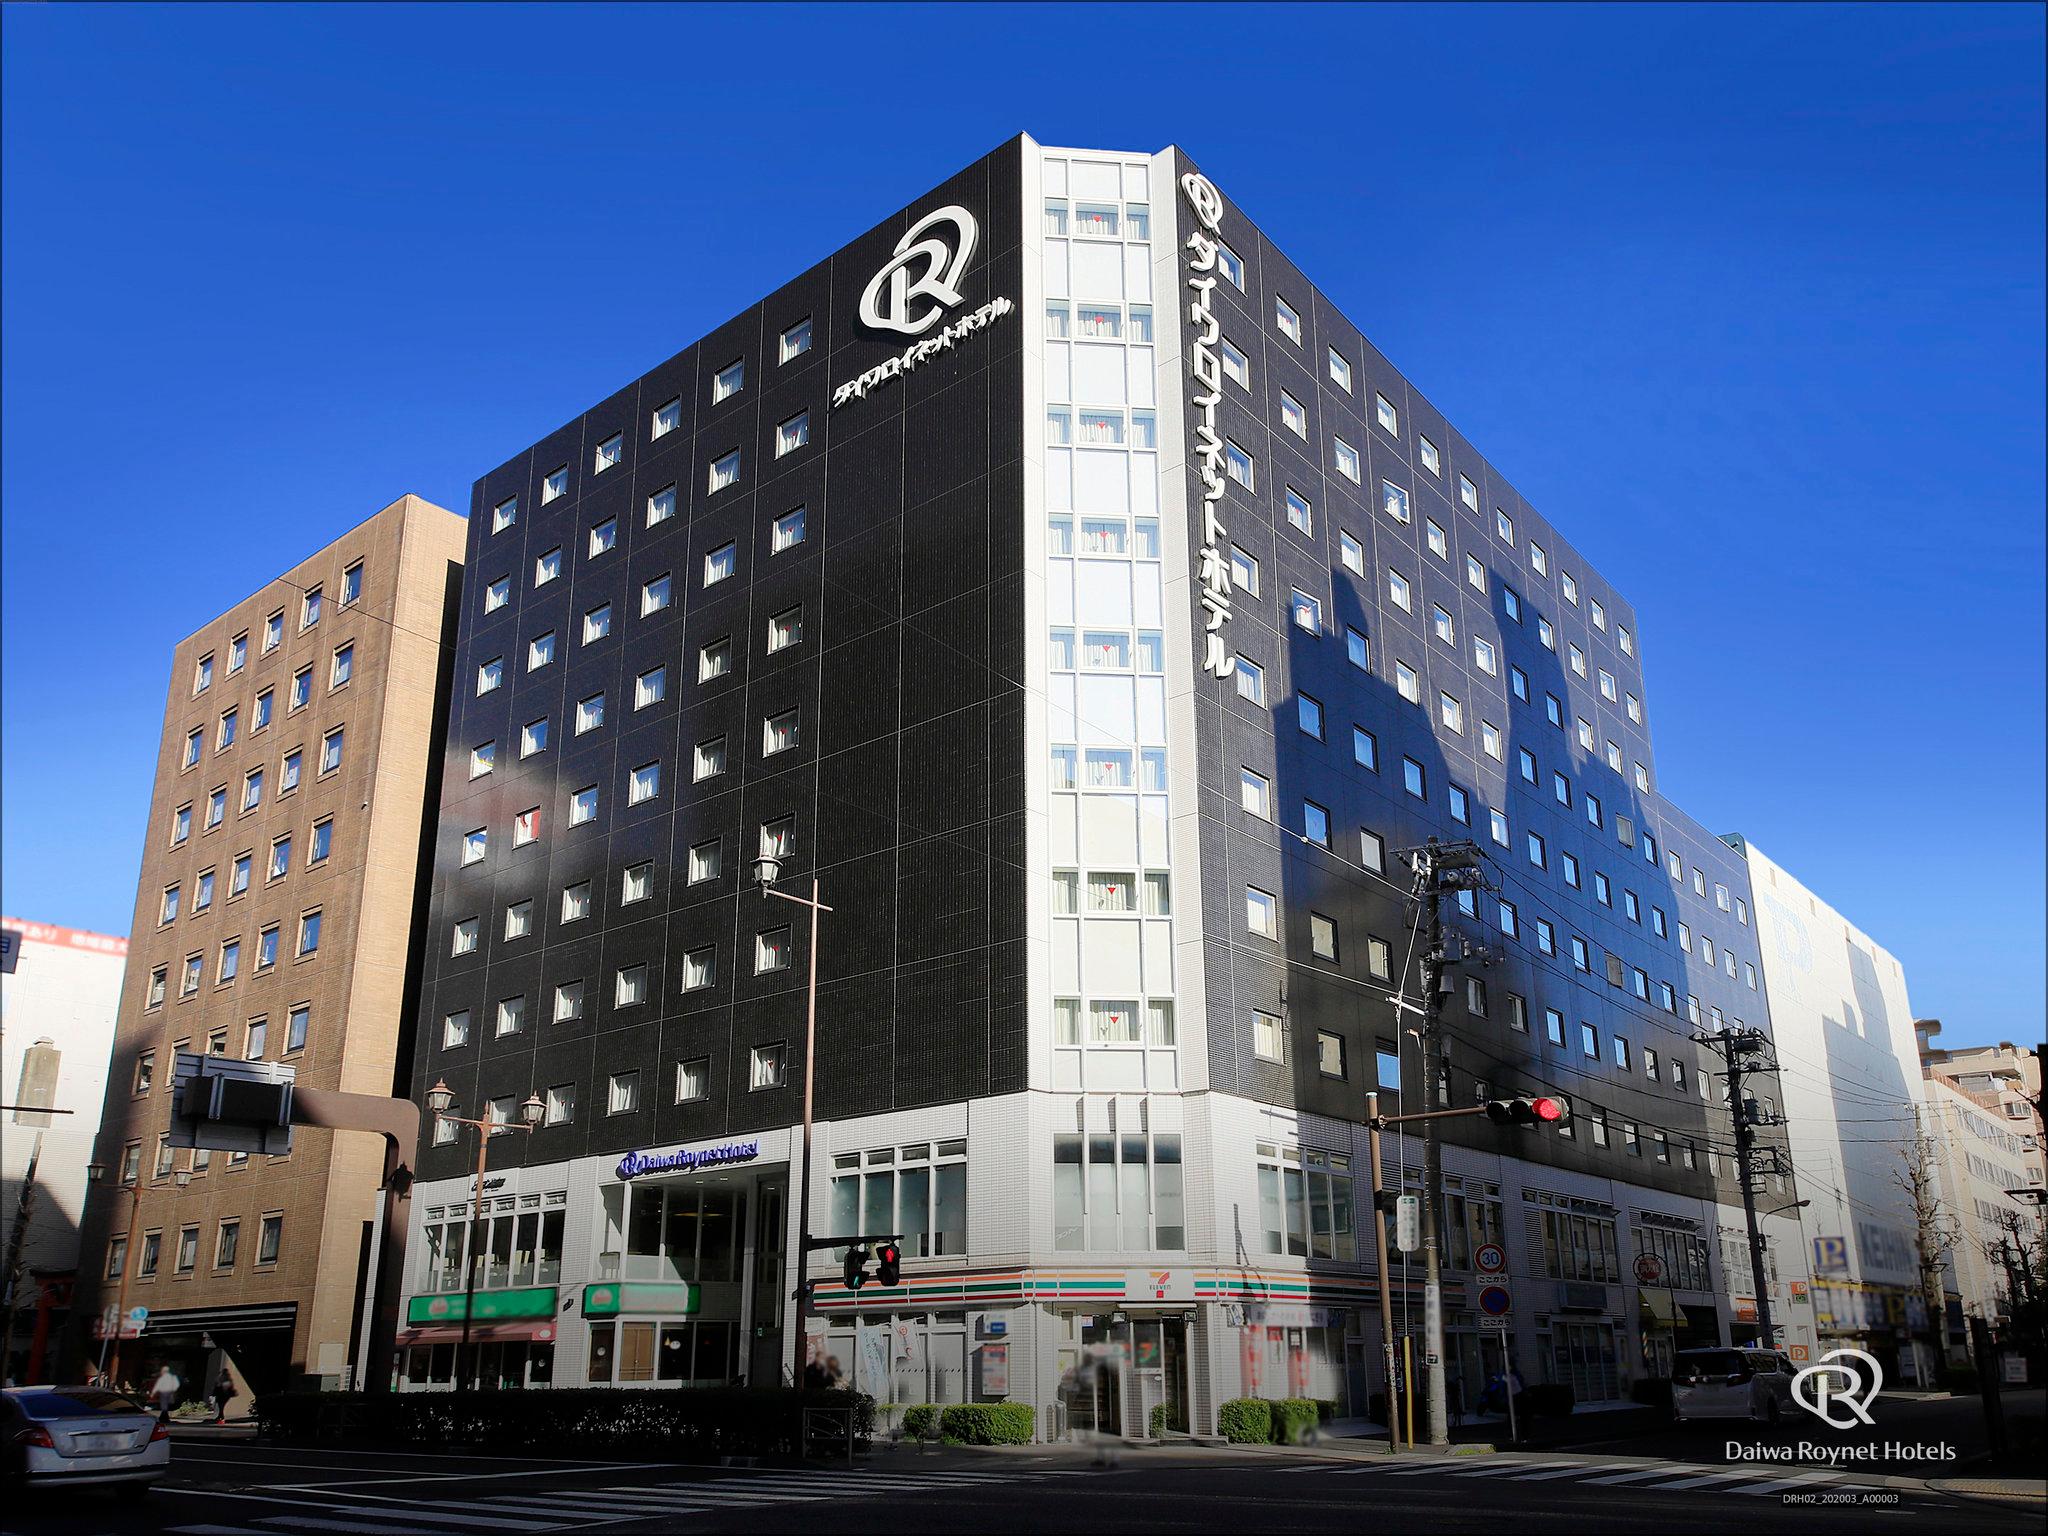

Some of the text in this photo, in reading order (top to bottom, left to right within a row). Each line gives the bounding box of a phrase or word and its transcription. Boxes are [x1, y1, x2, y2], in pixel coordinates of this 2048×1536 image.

[832, 295, 1015, 409] ダイワロイネットホテル
[1186, 230, 1236, 679] ダイワロイネットホテル
[641, 1153, 676, 1170] Daiwa
[676, 1148, 723, 1168] Roynet
[722, 1139, 759, 1159] Hotel
[1481, 1252, 1500, 1265] 30
[1479, 1276, 1508, 1284] ここから
[1483, 1318, 1511, 1327] ここから
